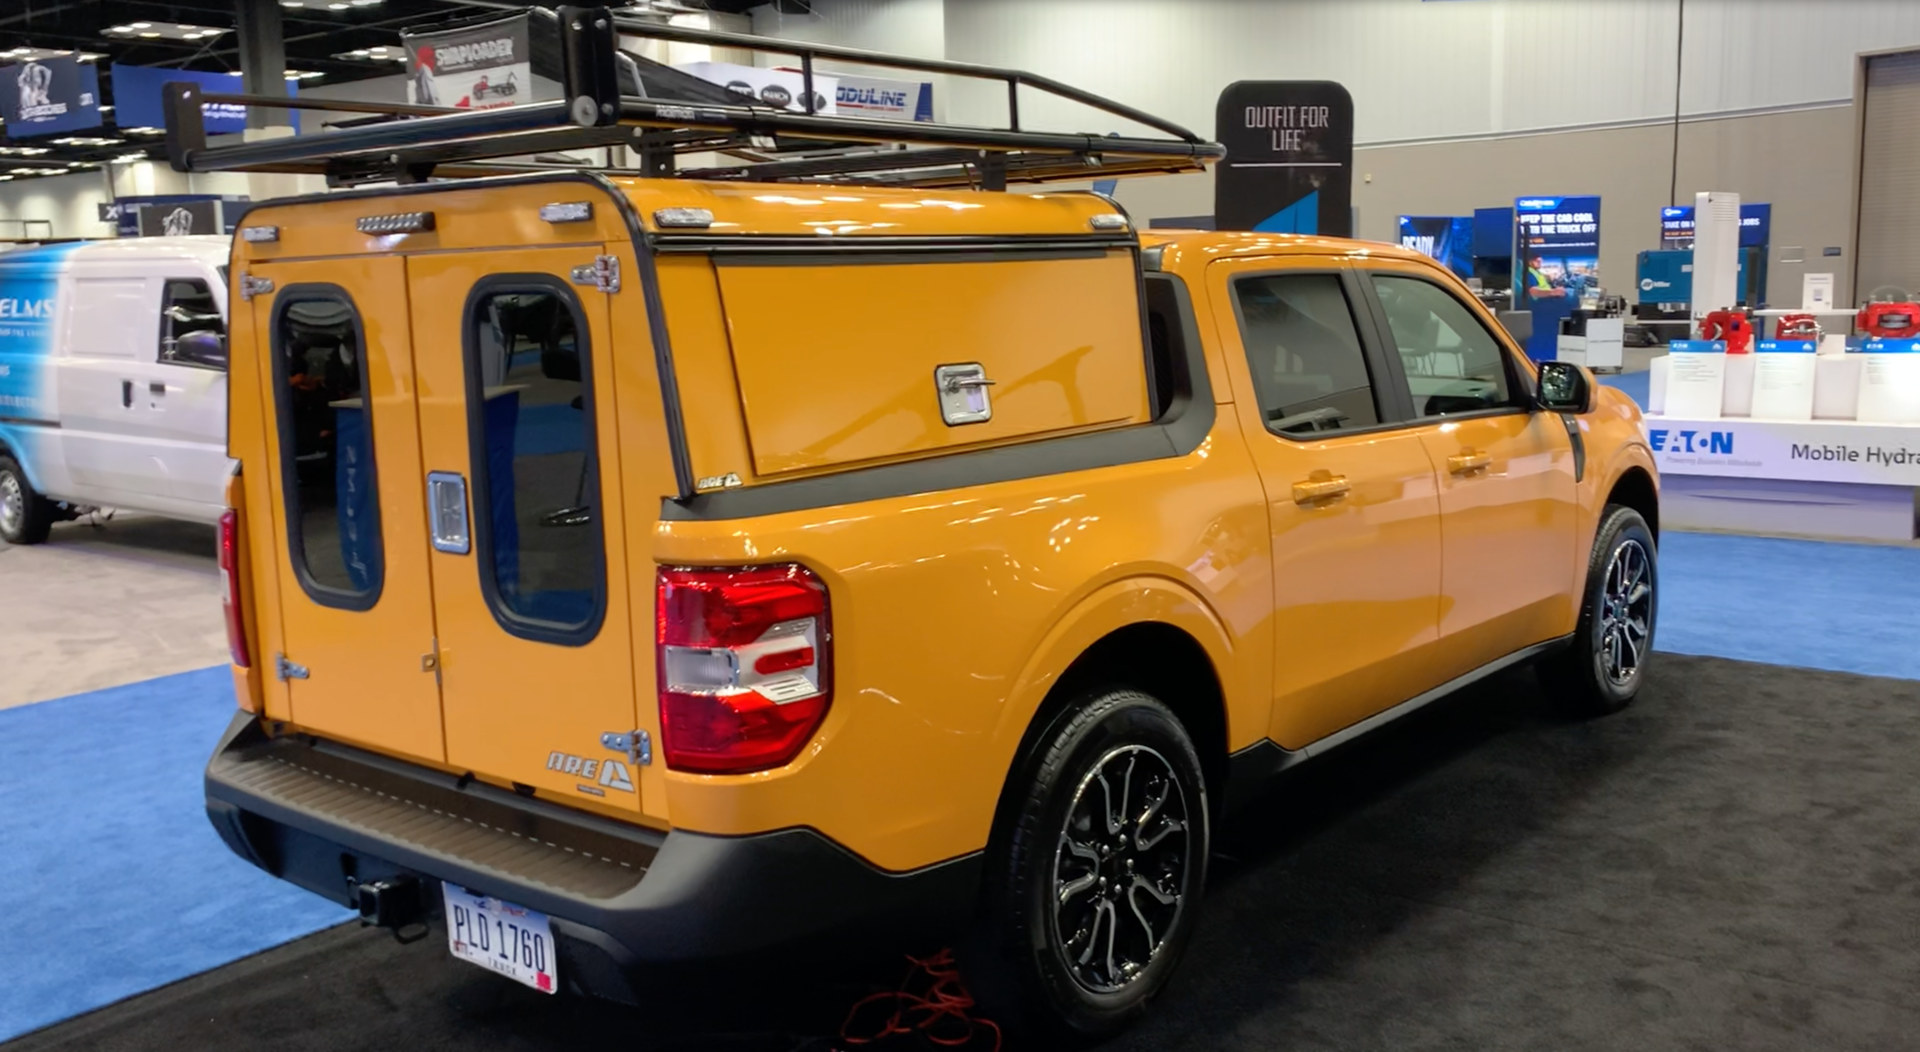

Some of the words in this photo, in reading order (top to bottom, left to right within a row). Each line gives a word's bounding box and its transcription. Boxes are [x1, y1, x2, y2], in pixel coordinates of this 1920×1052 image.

[1245, 106, 1297, 128] OUTFIT
[1300, 106, 1329, 128] FOR
[1272, 129, 1301, 151] LIFE
[1541, 214, 1556, 223] THE
[1556, 213, 1573, 223] CAB
[1573, 213, 1594, 223] COOL
[1541, 224, 1556, 234] THE
[1557, 224, 1581, 234] TRUCK
[1582, 223, 1597, 233] OFF
[1649, 429, 1734, 455] EATON
[1791, 443, 1860, 463] Mobile
[546, 751, 600, 779] ARE
[453, 904, 490, 952] PLD
[496, 920, 546, 973] 1760
